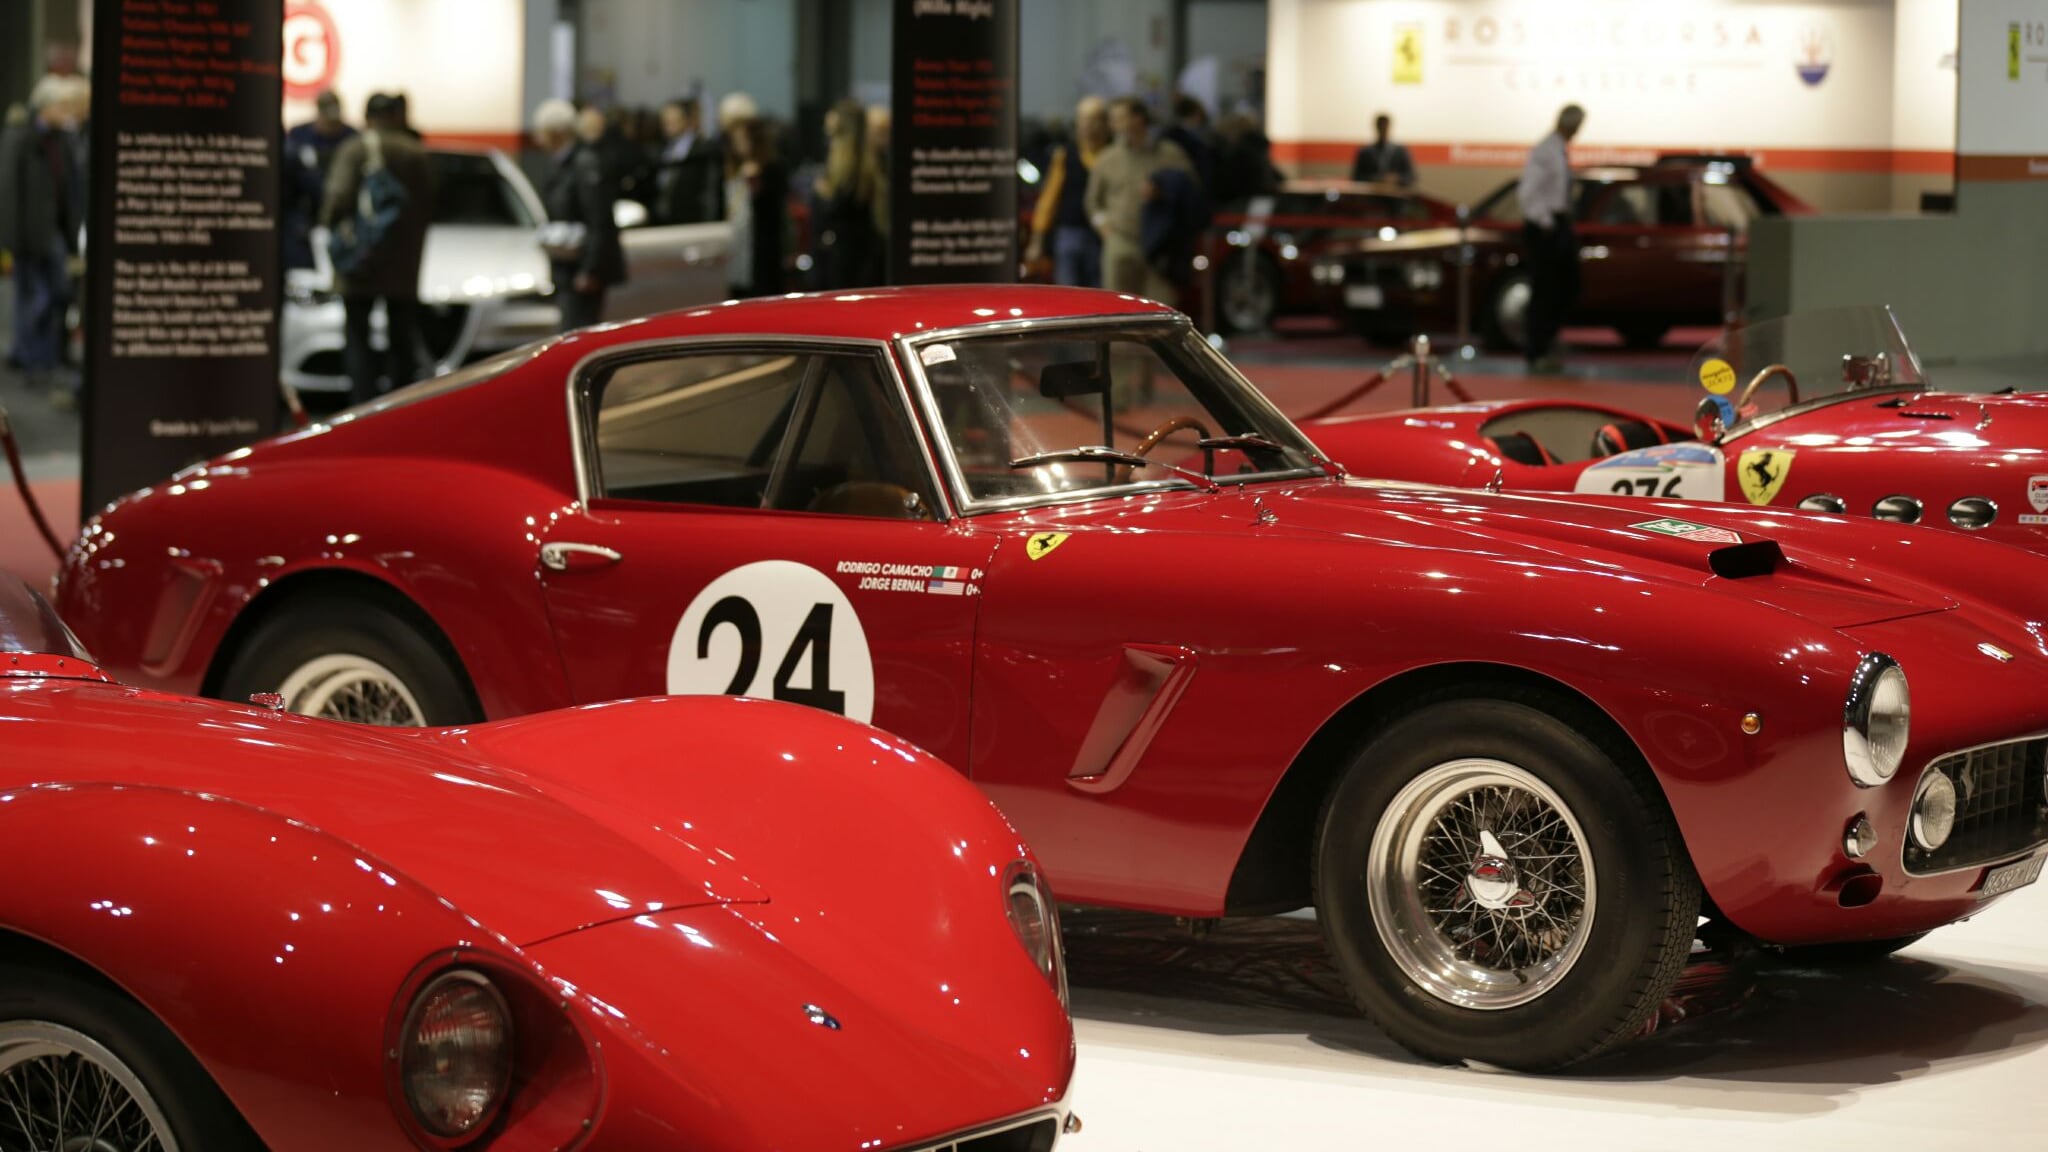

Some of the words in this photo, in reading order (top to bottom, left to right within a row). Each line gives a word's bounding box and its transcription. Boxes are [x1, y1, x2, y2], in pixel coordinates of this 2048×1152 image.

[836, 560, 881, 575] RODRIGO
[881, 564, 933, 578] CAMACHO
[858, 577, 890, 591] JORGE
[890, 578, 926, 593] BERNAL
[697, 595, 845, 717] 24
